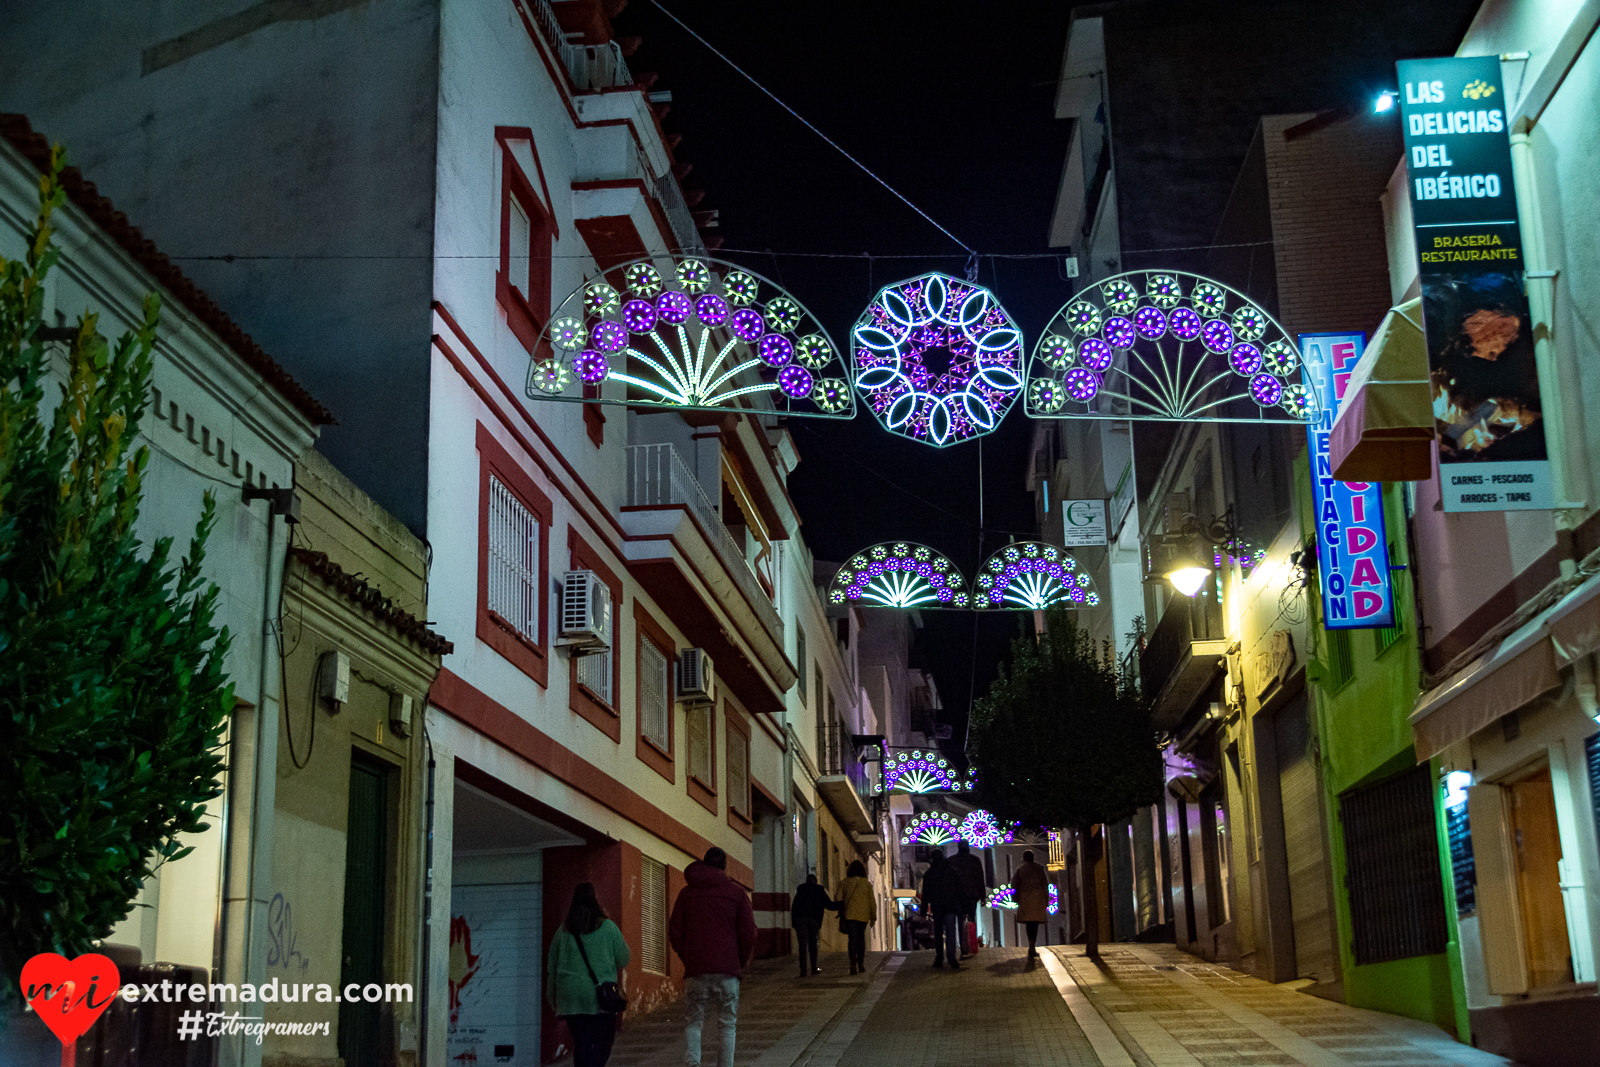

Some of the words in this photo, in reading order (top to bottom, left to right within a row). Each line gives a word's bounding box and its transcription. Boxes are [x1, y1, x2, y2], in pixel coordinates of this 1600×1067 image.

[1405, 81, 1445, 105] LAS
[1408, 110, 1504, 136] DELICIAS
[1412, 145, 1453, 168] DEL
[1415, 171, 1501, 201] IBÉRICO
[1421, 248, 1518, 263] RESTAURANTE
[1331, 342, 1384, 619] FIDAD
[1451, 475, 1483, 485] CARNES
[1491, 474, 1534, 484] PESCADOS
[1460, 493, 1497, 503] ARROCES
[1505, 492, 1531, 502] TAPAS
[1067, 501, 1097, 526] G
